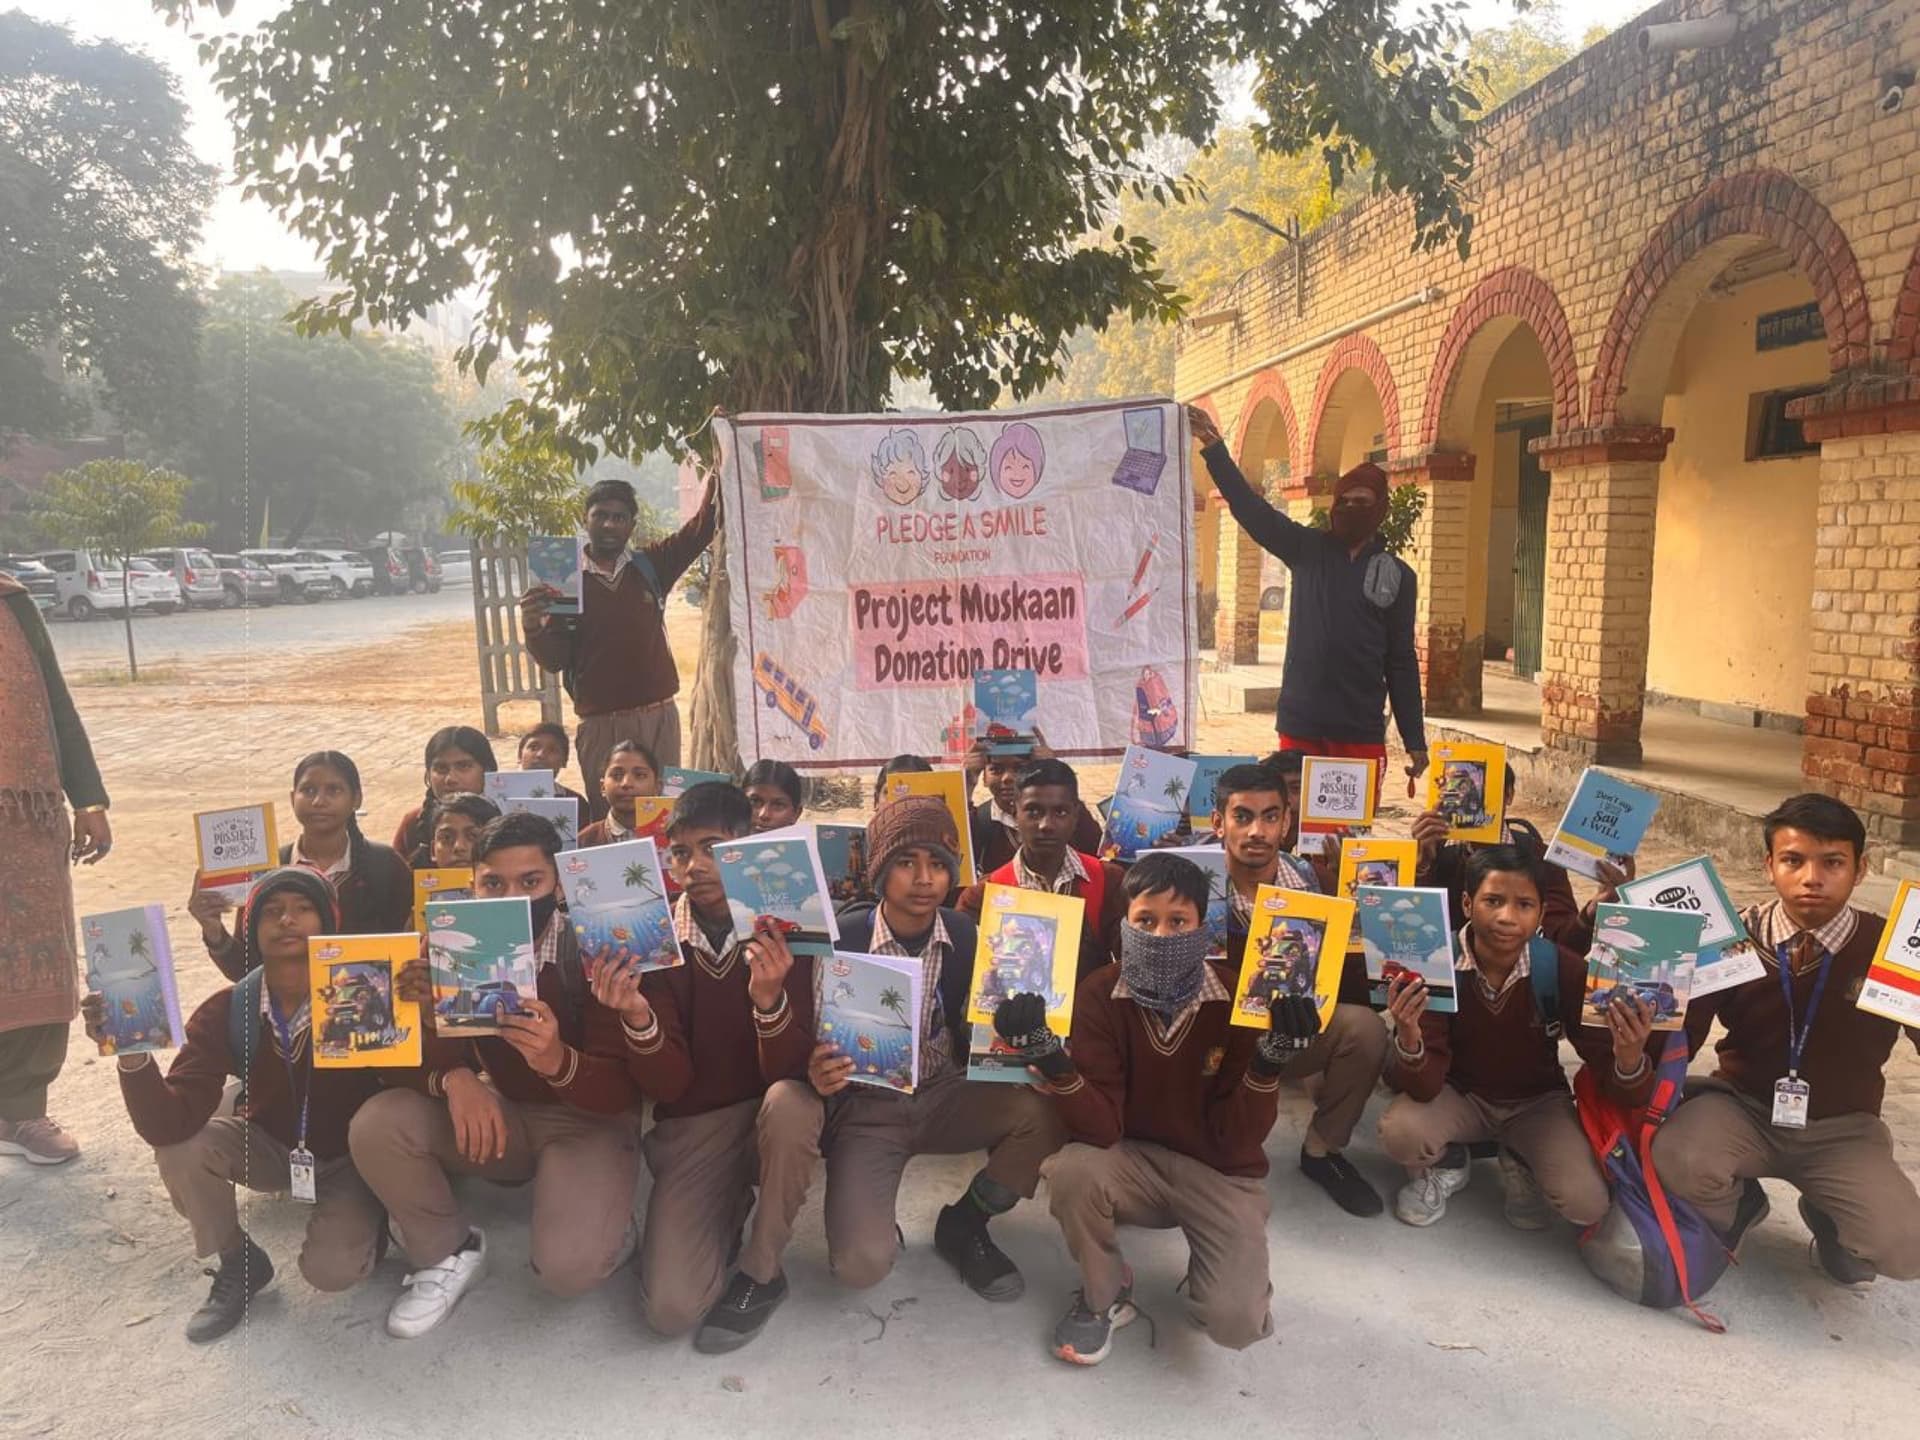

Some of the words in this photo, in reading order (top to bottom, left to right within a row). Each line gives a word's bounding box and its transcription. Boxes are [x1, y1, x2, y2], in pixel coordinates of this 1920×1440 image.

[876, 512, 957, 544] PLEDGE
[962, 511, 977, 540] A
[980, 505, 1047, 539] SMILE
[934, 550, 992, 564] FOUNDATION
[855, 584, 953, 642] Project
[960, 580, 1076, 624] Muskaan
[874, 640, 985, 683] Donation
[992, 637, 1063, 675] Drive
[1319, 782, 1357, 796] POSSIBLE
[1592, 809, 1619, 828] Say
[1590, 820, 1621, 841] WILL
